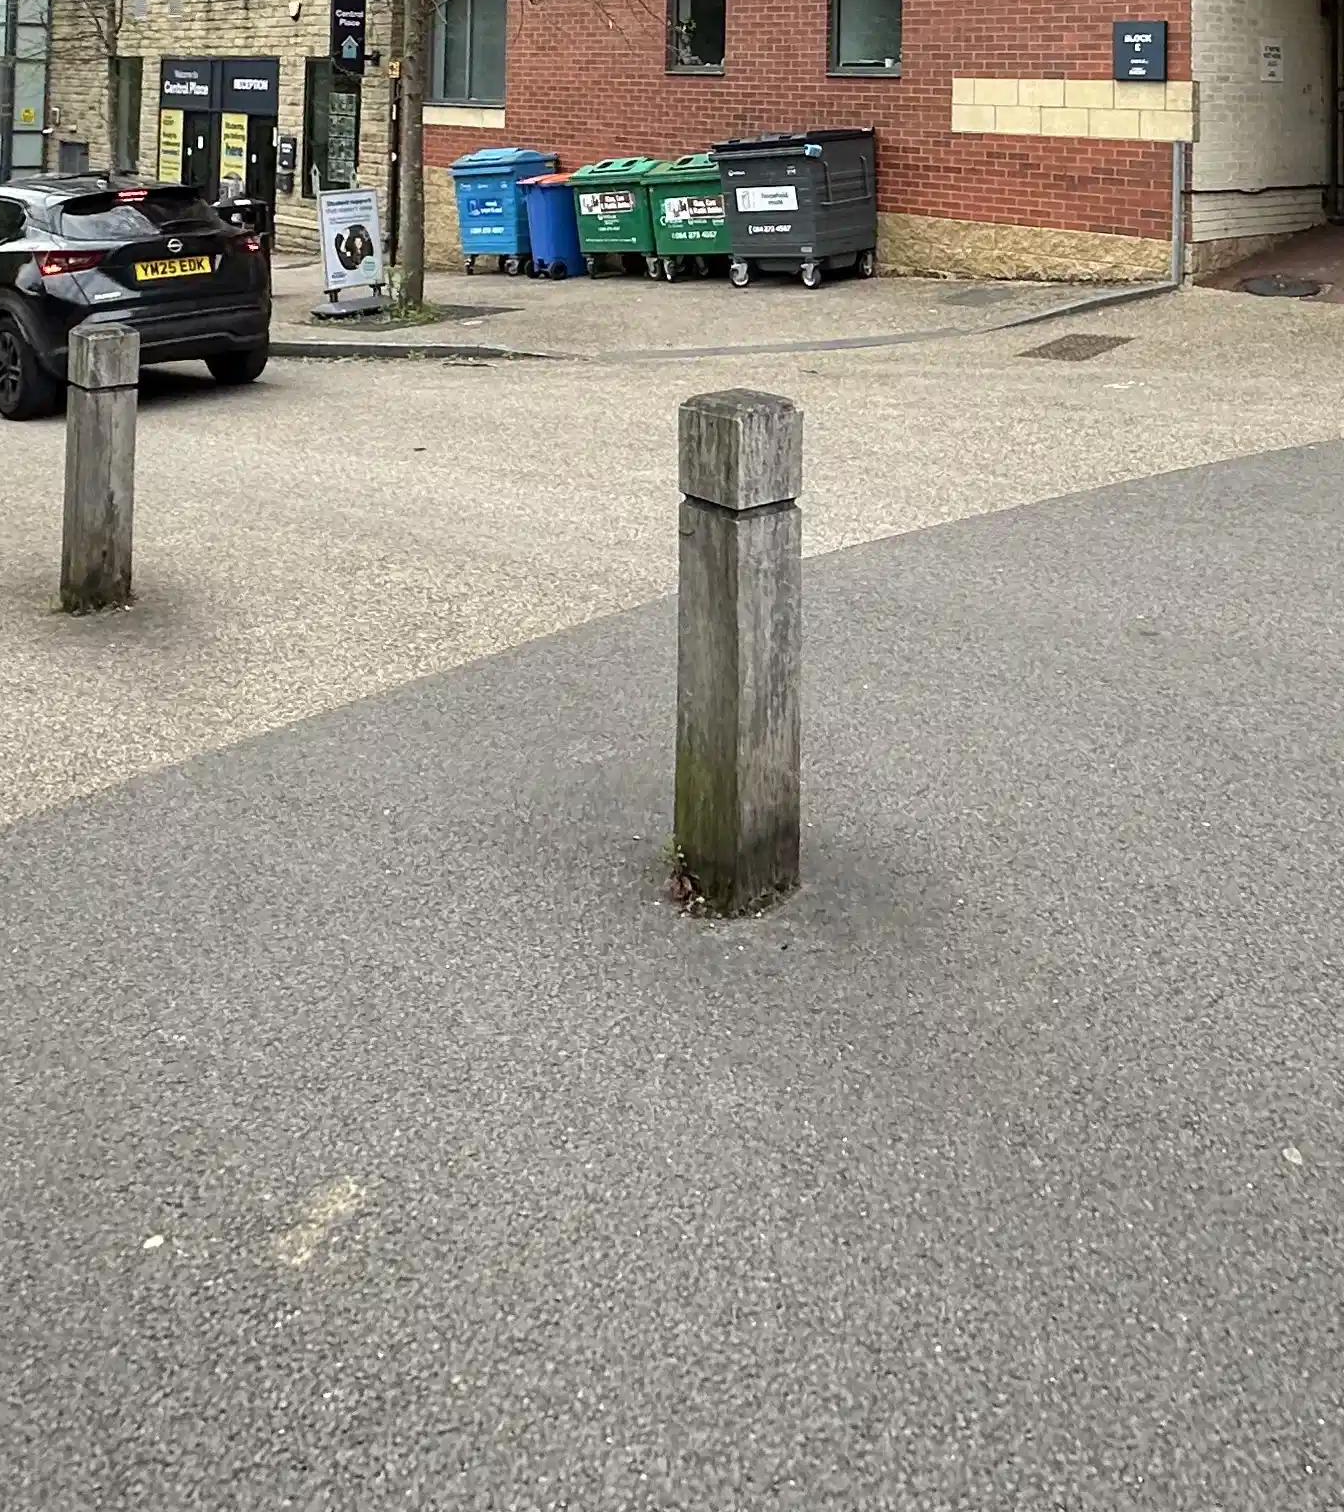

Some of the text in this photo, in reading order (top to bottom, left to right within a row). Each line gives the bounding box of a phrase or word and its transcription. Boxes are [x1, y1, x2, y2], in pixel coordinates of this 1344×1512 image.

[335, 9, 364, 18] Central
[339, 18, 360, 26] Place
[1124, 34, 1152, 43] BLOCK
[164, 80, 209, 95] Central Place
[233, 78, 269, 91] RECEPTION
[179, 257, 205, 273] EDK
